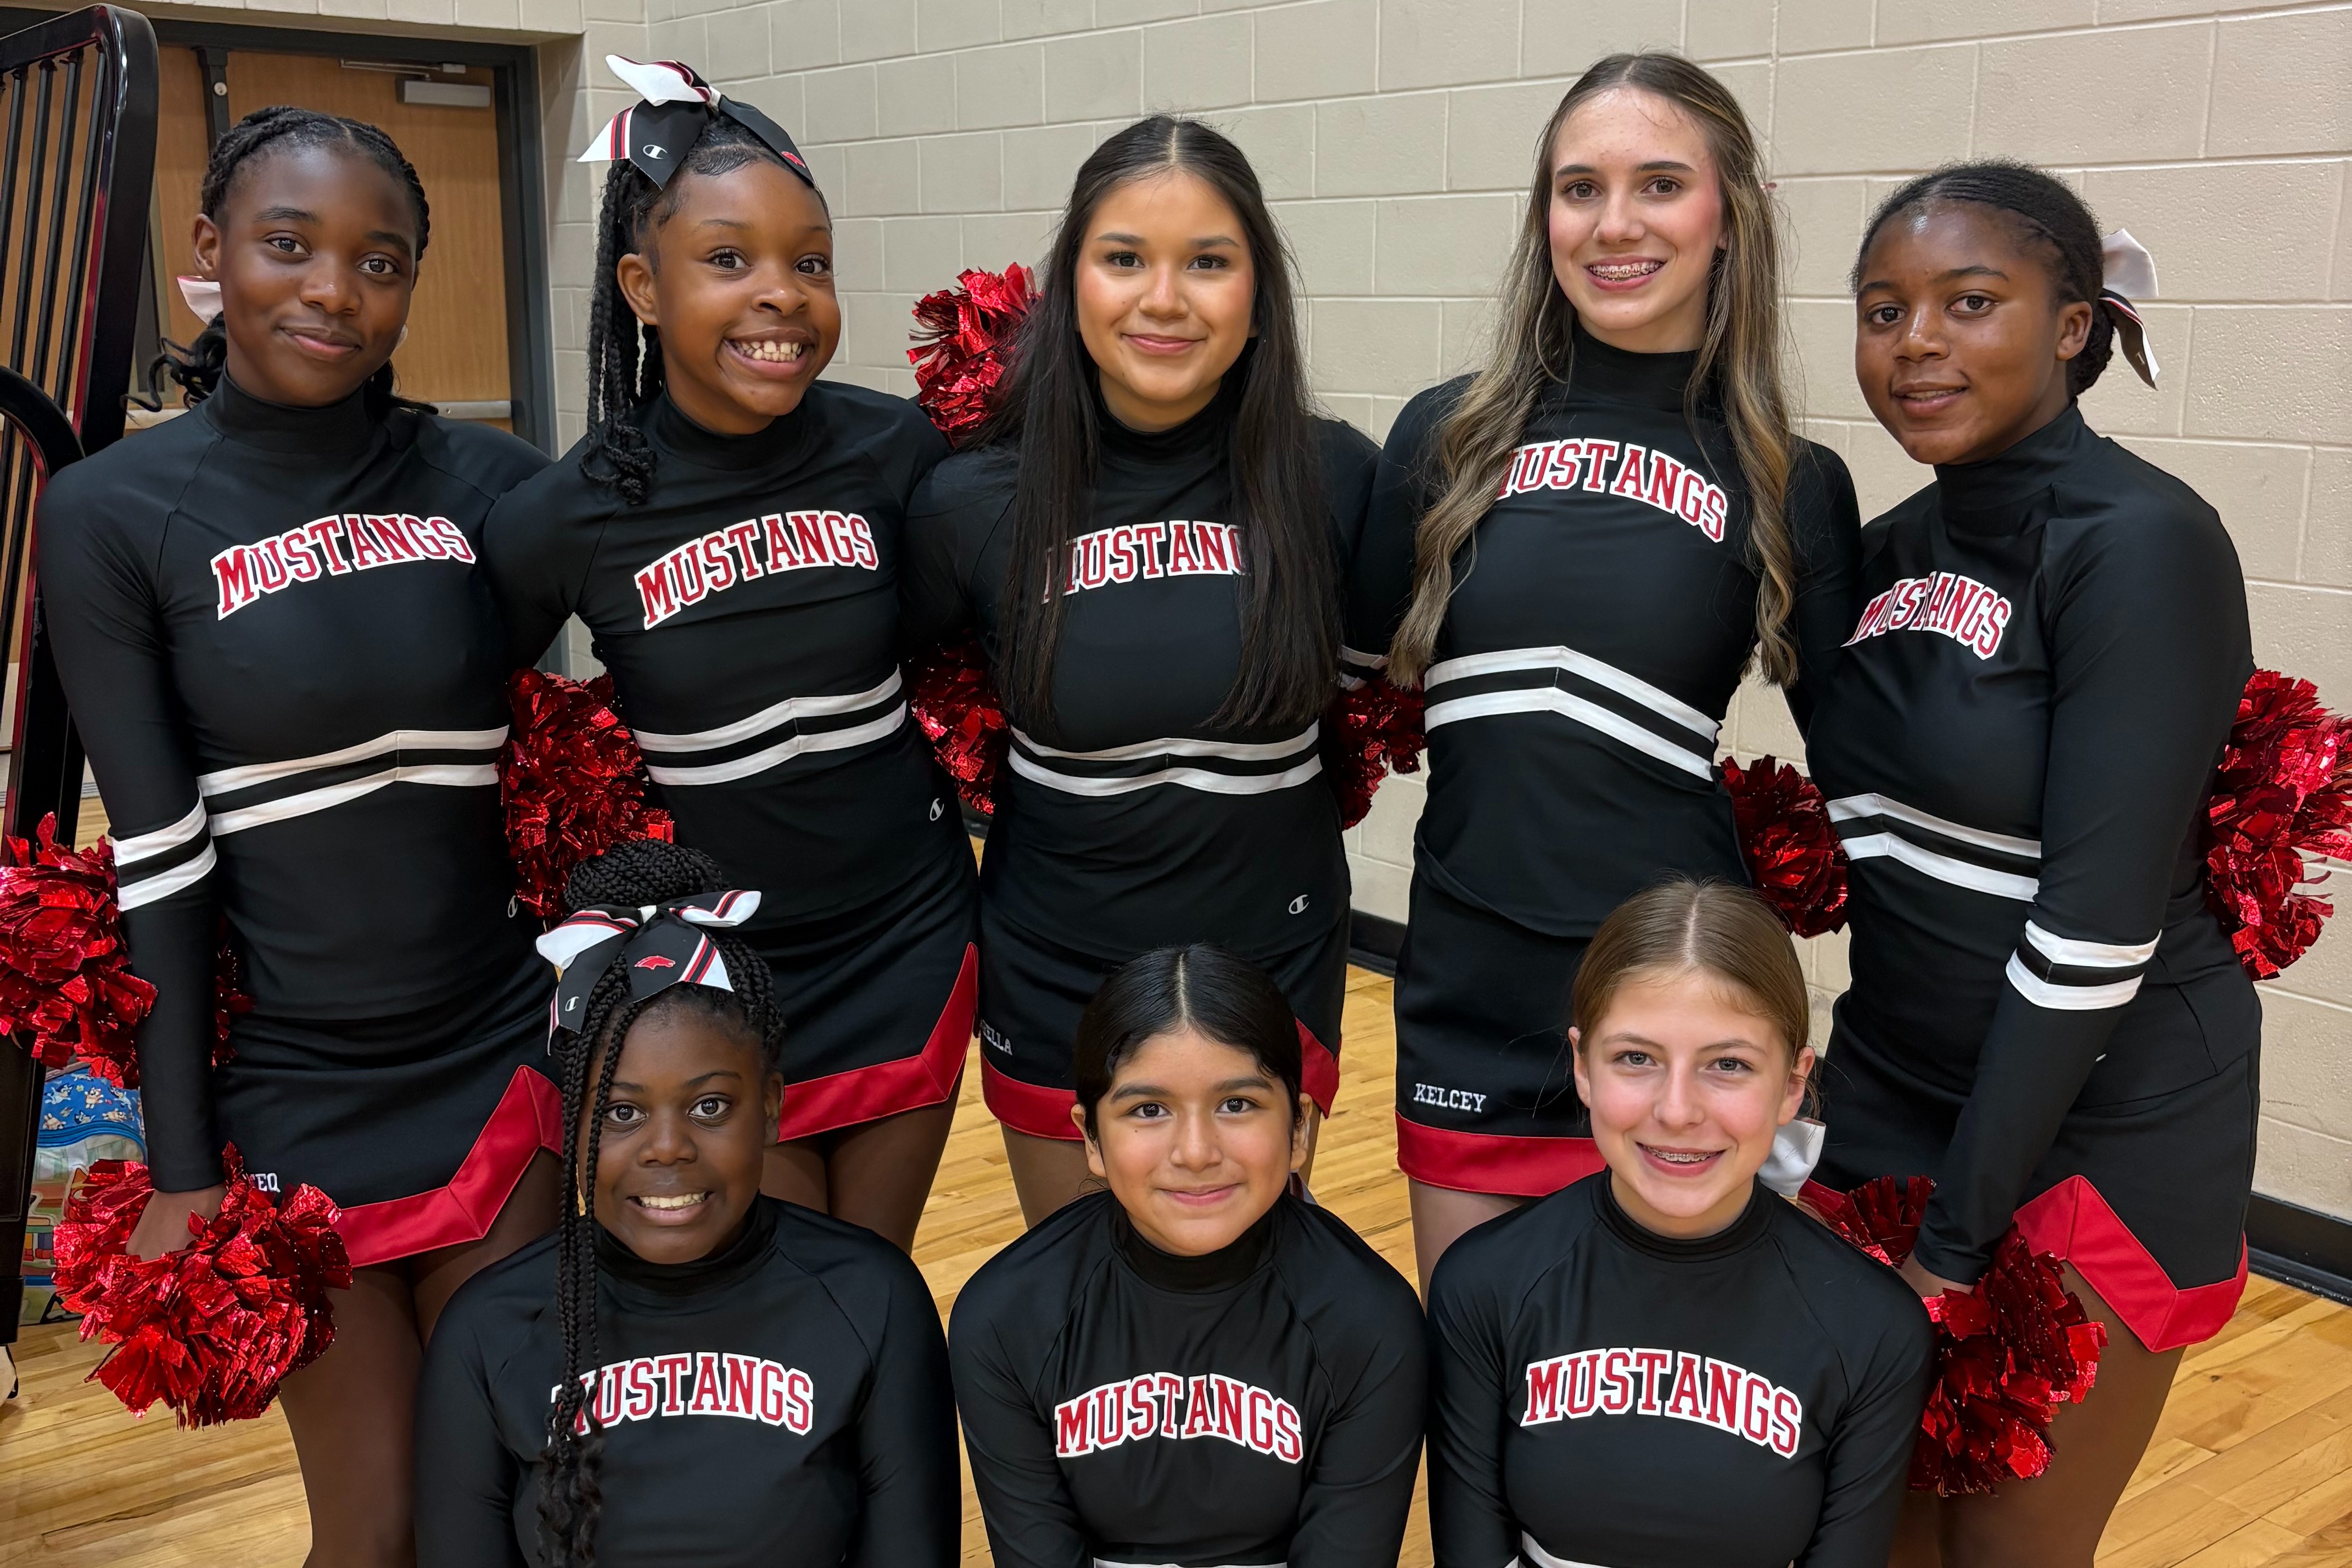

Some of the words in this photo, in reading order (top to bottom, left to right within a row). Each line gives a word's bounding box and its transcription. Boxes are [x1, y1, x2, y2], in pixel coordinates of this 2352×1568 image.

[210, 513, 477, 621] MUSTANGS
[634, 510, 880, 631] MUSTANGS
[1041, 519, 1252, 604] USTAN
[1840, 570, 2012, 660] MUSTANGS
[980, 1018, 1013, 1056] ELLA
[1413, 1083, 1487, 1113] KELCEY
[1055, 1371, 1304, 1464] MUSTANGS
[1520, 1347, 1802, 1459] MUSTANGS
